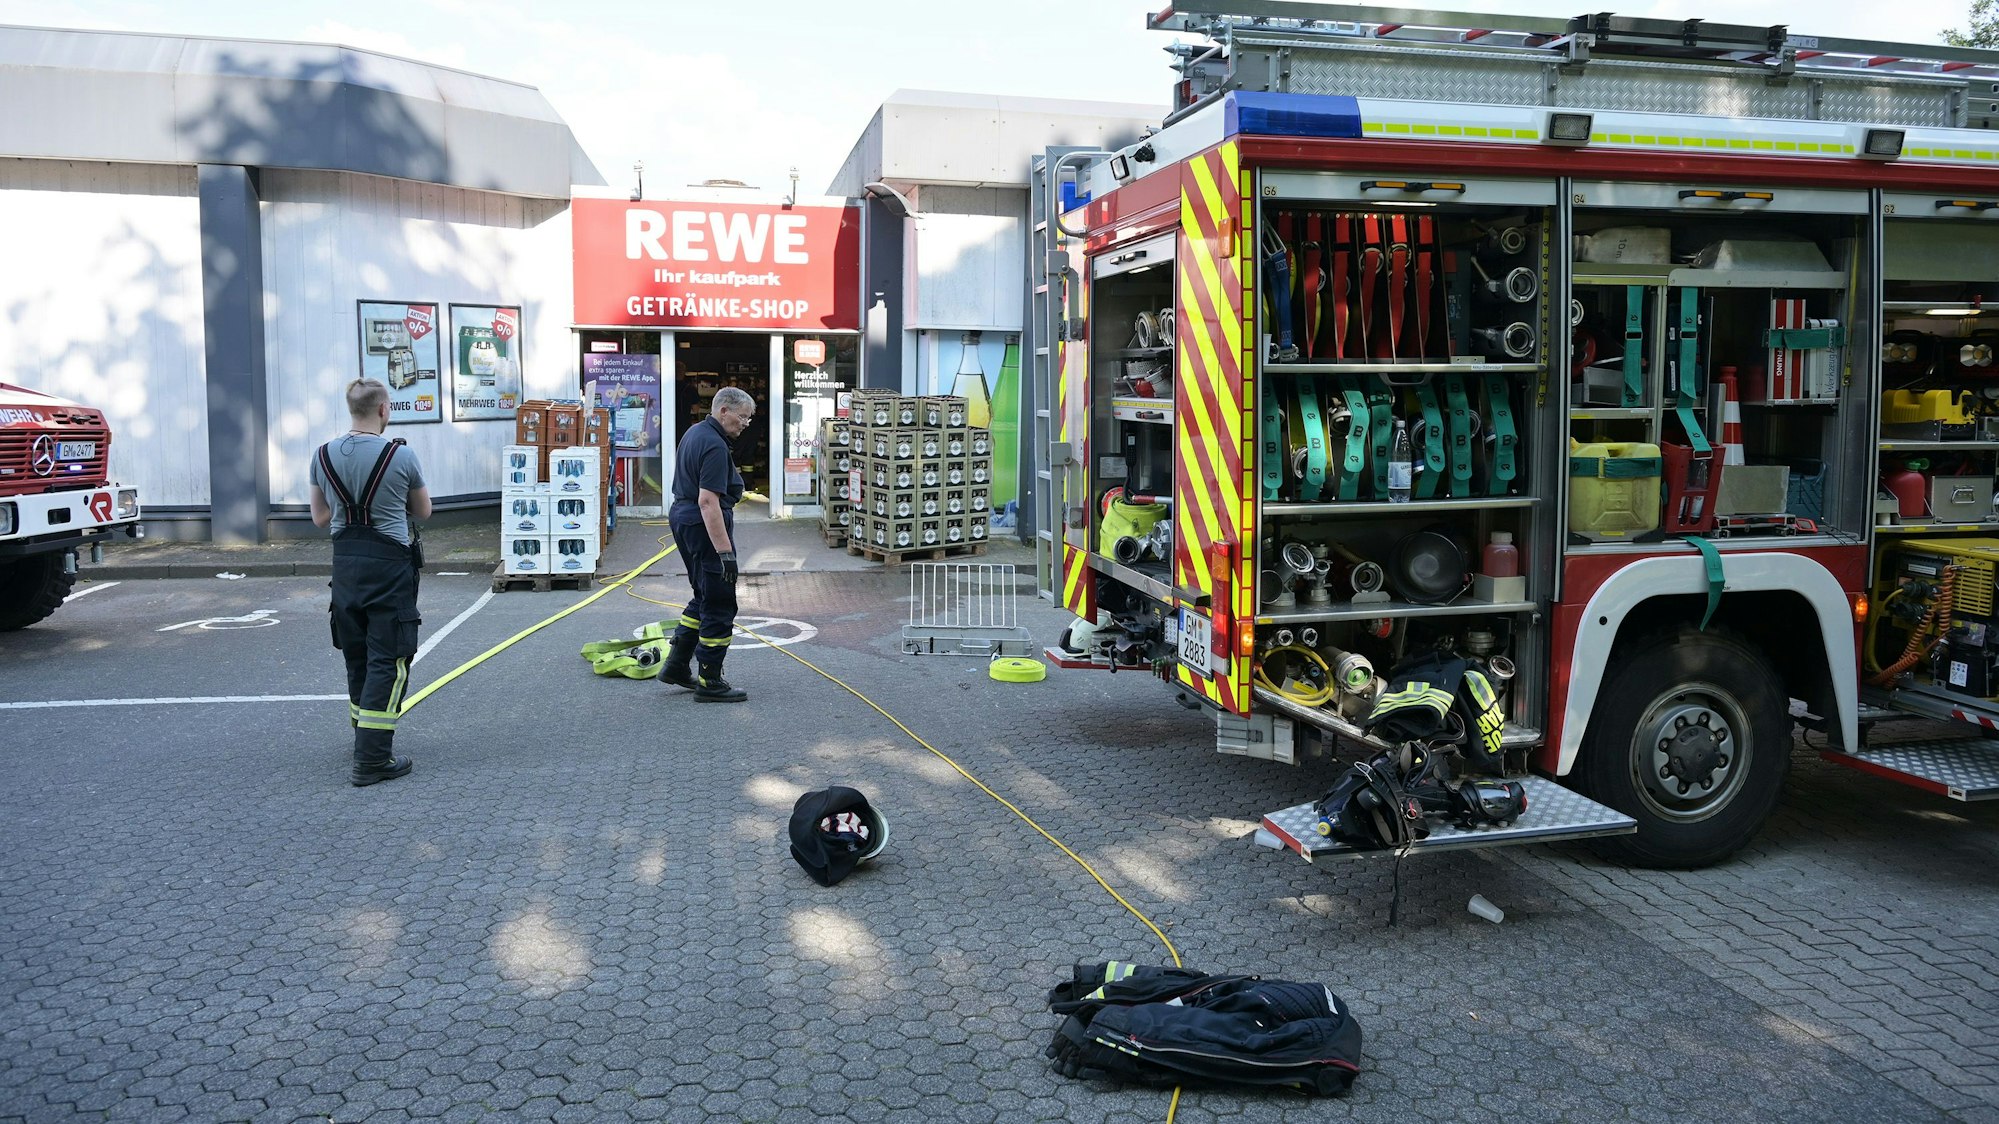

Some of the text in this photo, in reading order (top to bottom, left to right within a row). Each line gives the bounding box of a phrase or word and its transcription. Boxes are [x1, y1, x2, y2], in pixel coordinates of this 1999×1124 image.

[1264, 186, 1276, 196] G6
[1573, 194, 1584, 204] G4
[1884, 204, 1894, 214] G2
[625, 209, 809, 264] REWE
[654, 268, 781, 288] Ihr kaufpark
[626, 293, 809, 320] GETRÄNKE-SHOP
[410, 310, 428, 320] AKTION
[604, 358, 621, 367] jedem
[642, 374, 656, 382] App.
[794, 370, 829, 380] Herzlich
[794, 380, 845, 389] willkommen
[458, 399, 496, 408] MEHRWEG
[64, 444, 92, 456] GM 2477
[1186, 614, 1197, 638] GM
[1184, 638, 1205, 666] 2883
